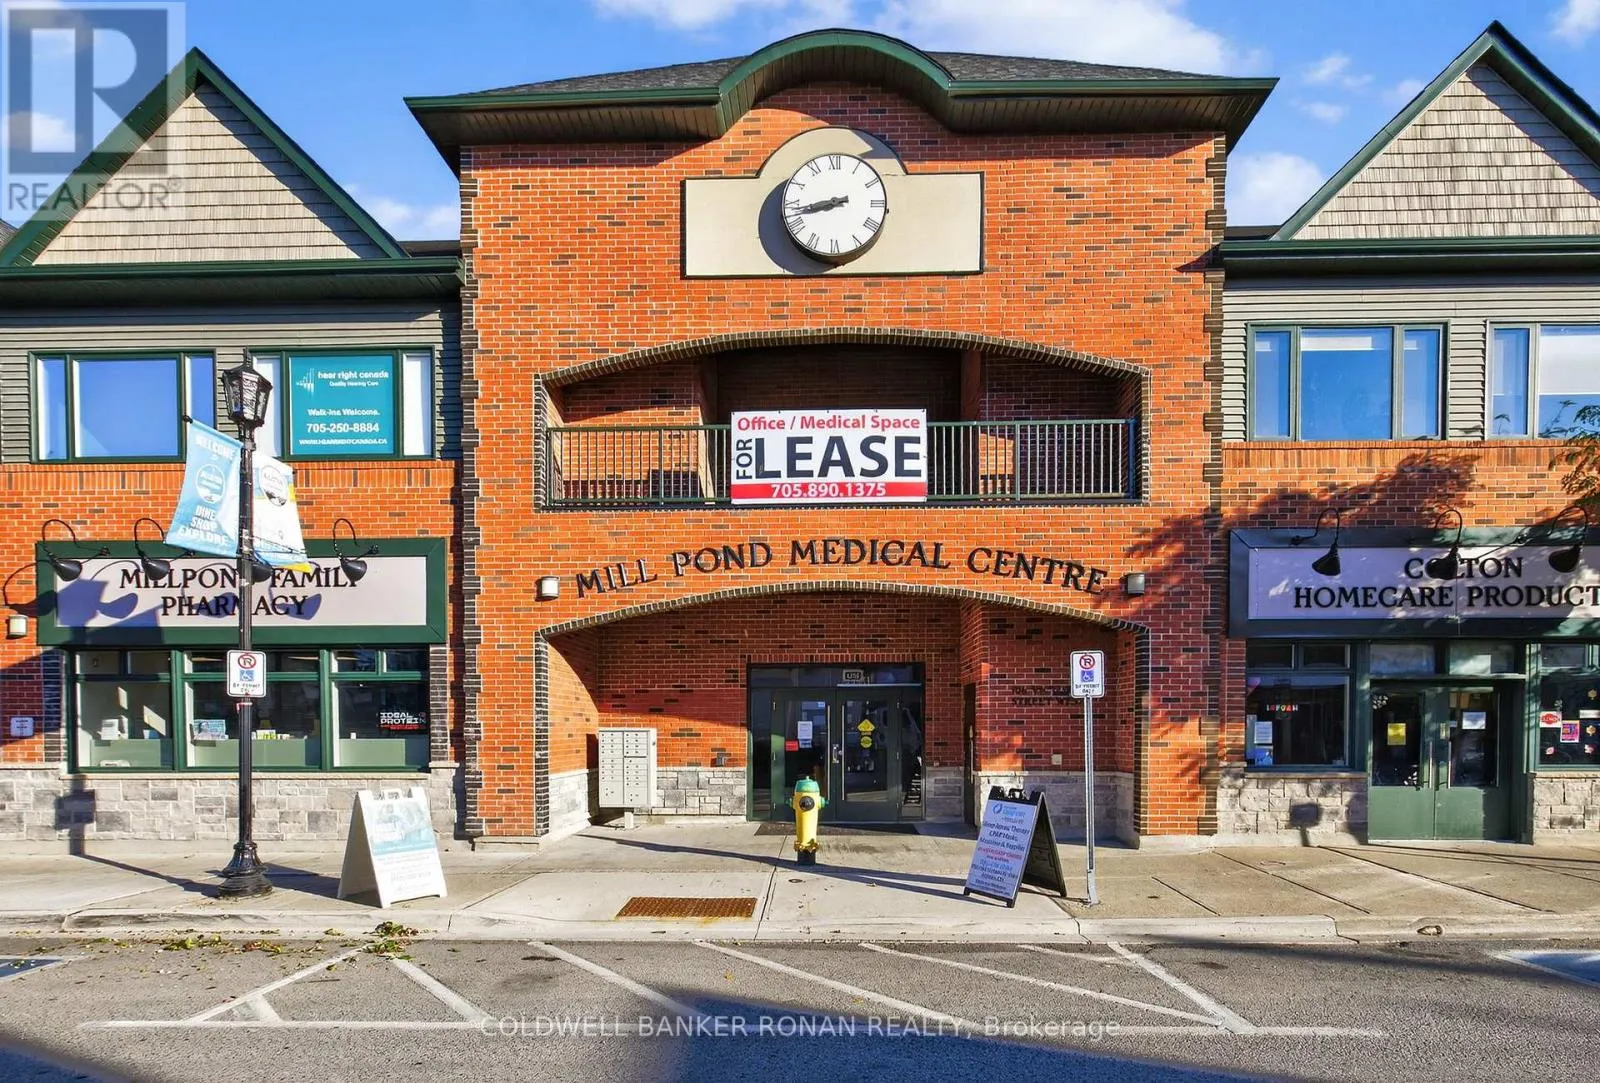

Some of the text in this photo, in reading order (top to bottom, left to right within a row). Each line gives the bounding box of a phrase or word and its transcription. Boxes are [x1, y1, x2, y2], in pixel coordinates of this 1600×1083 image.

[317, 370, 389, 380] hear right canada
[306, 422, 379, 433] 705-250-8884
[737, 414, 920, 433] Office / Medical Space
[735, 438, 753, 480] FOR
[755, 435, 922, 479] LEASE
[771, 482, 887, 498] 705.890.1375
[575, 538, 1108, 599] MILL POND MEDICAL CENTRE
[1404, 556, 1523, 579] CTON
[119, 568, 242, 589] MILLPON
[1294, 586, 1454, 608] HOMECARE
